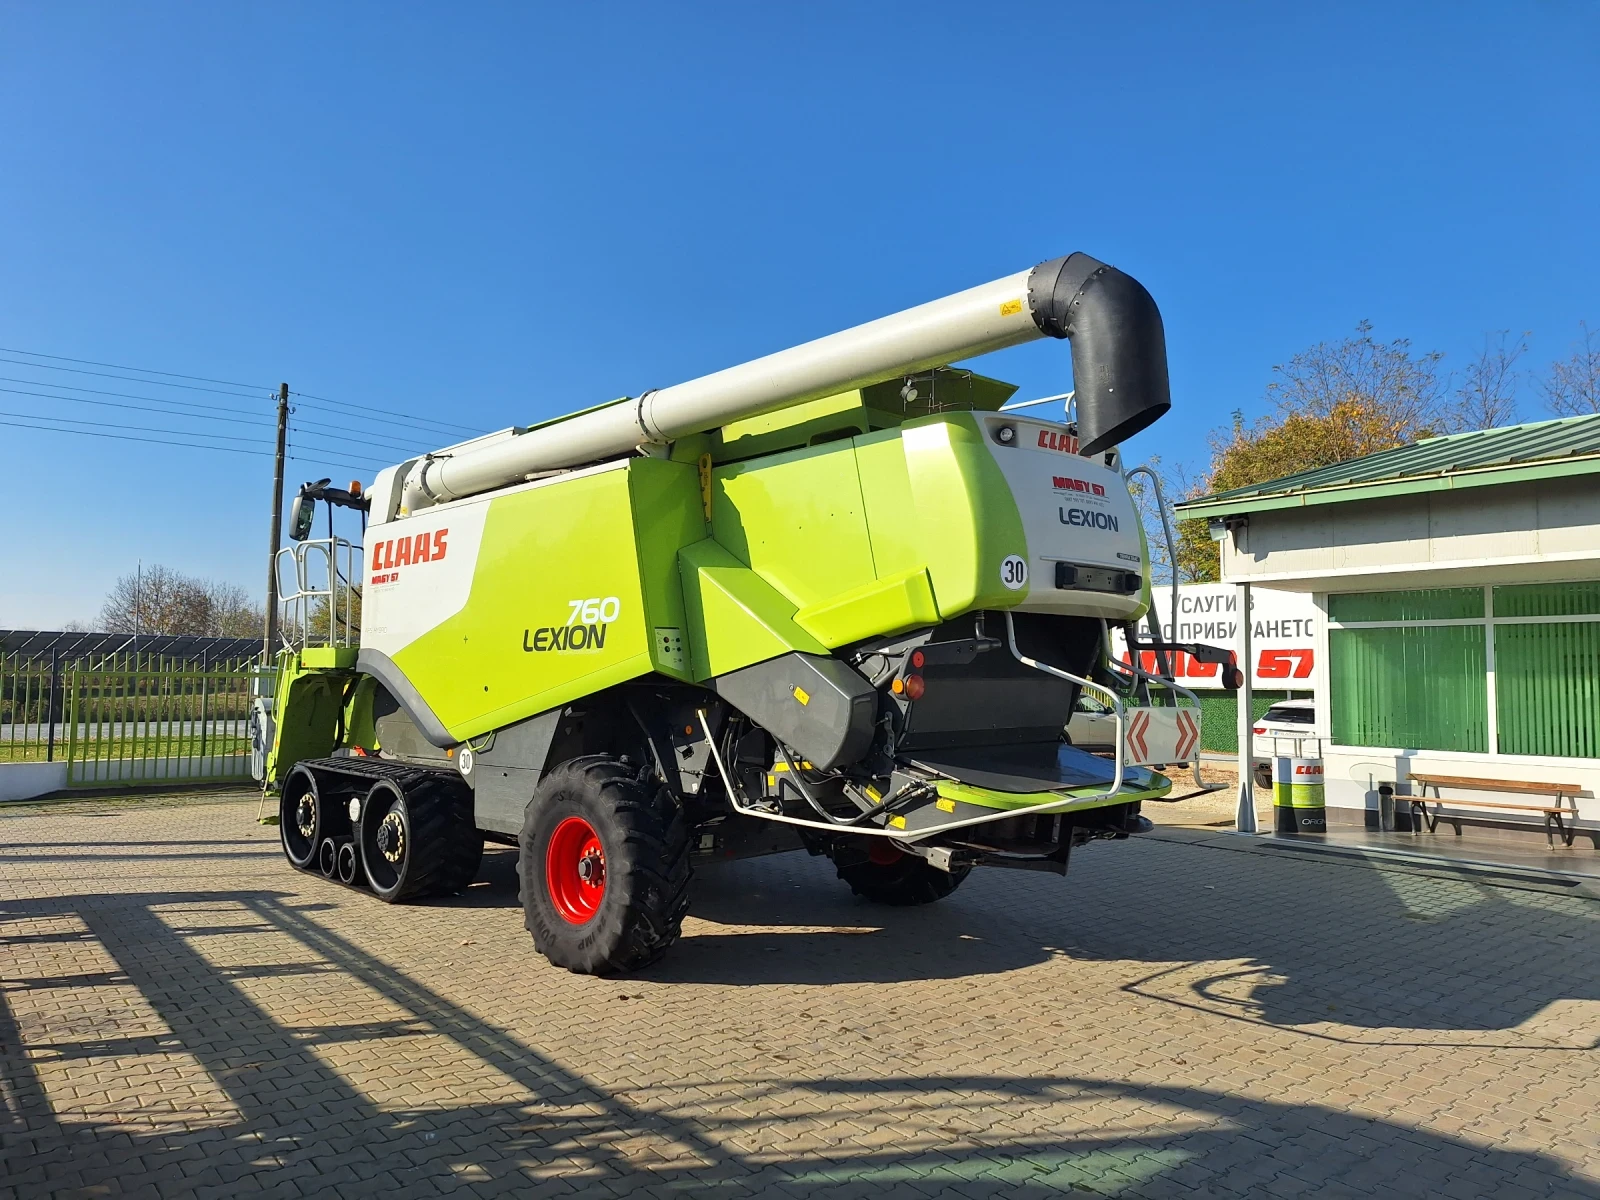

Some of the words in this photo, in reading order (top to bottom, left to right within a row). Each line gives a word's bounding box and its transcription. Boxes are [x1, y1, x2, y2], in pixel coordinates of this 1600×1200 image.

[1059, 507, 1119, 532] LEXION
[372, 528, 448, 570] CLAAS
[1005, 560, 1024, 584] 30
[566, 596, 620, 626] 760
[523, 623, 607, 652] LEXION
[1256, 649, 1314, 678] 57
[461, 753, 470, 770] 30
